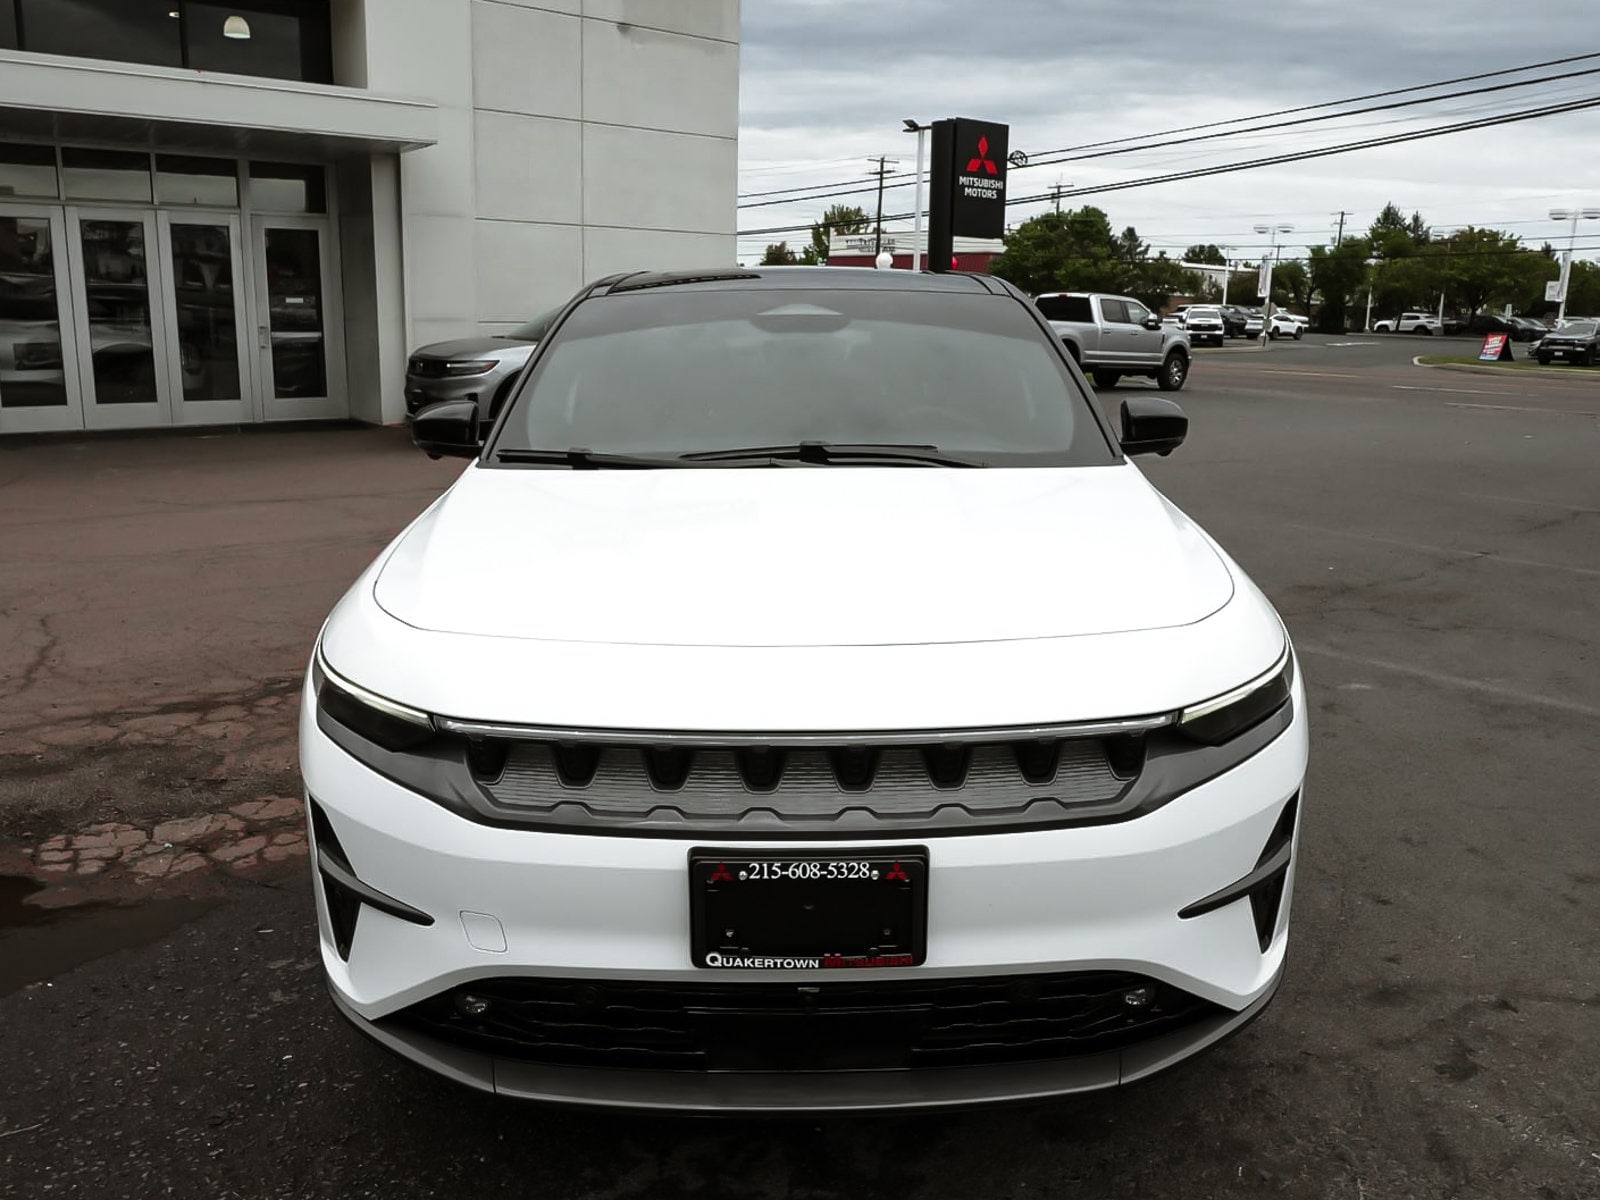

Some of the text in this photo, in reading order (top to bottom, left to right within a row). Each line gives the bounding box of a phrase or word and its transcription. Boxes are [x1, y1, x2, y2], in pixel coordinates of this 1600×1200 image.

[959, 176, 1004, 189] MITSUBISHI
[965, 187, 997, 199] MOTORS
[749, 862, 870, 879] 215-608-5328
[706, 952, 819, 968] QUAKERTOWN
